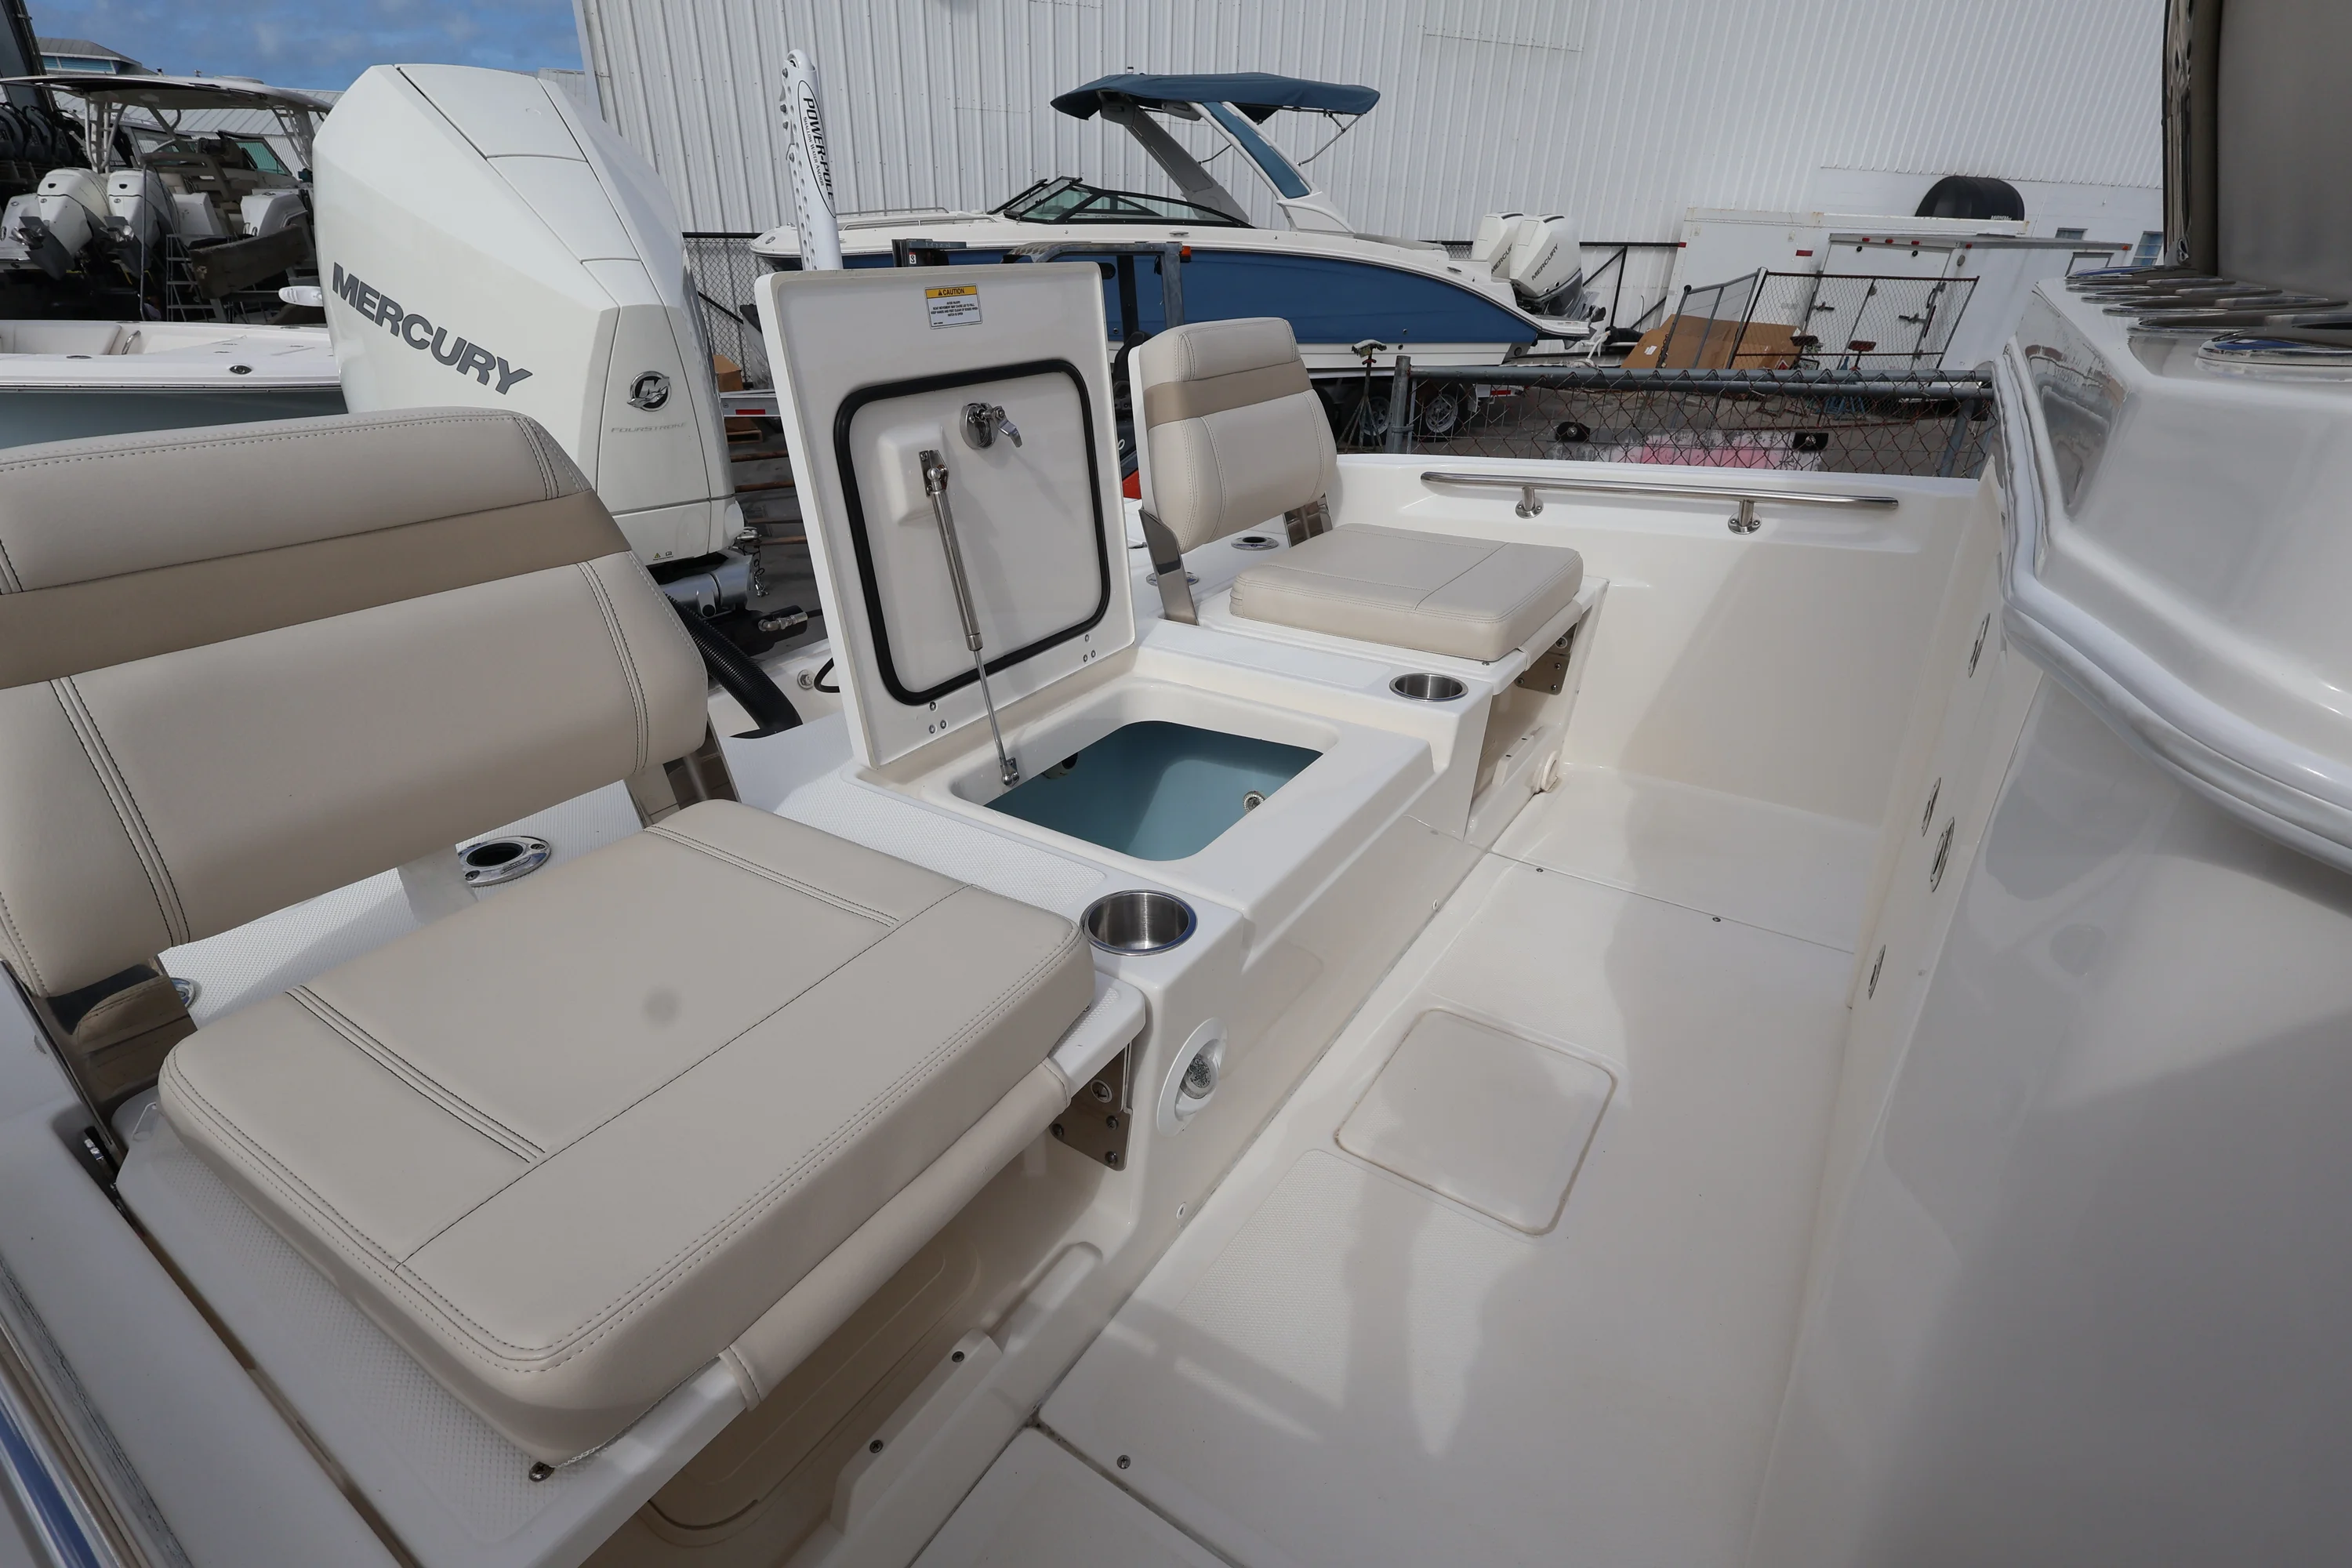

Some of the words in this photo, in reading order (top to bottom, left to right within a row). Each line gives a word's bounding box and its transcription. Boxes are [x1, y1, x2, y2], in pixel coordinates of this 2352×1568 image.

[803, 98, 833, 200] POWER-POLE
[1491, 241, 1513, 274] MERCU
[1531, 242, 1559, 281] MERCURY
[332, 261, 533, 395] MERCURY
